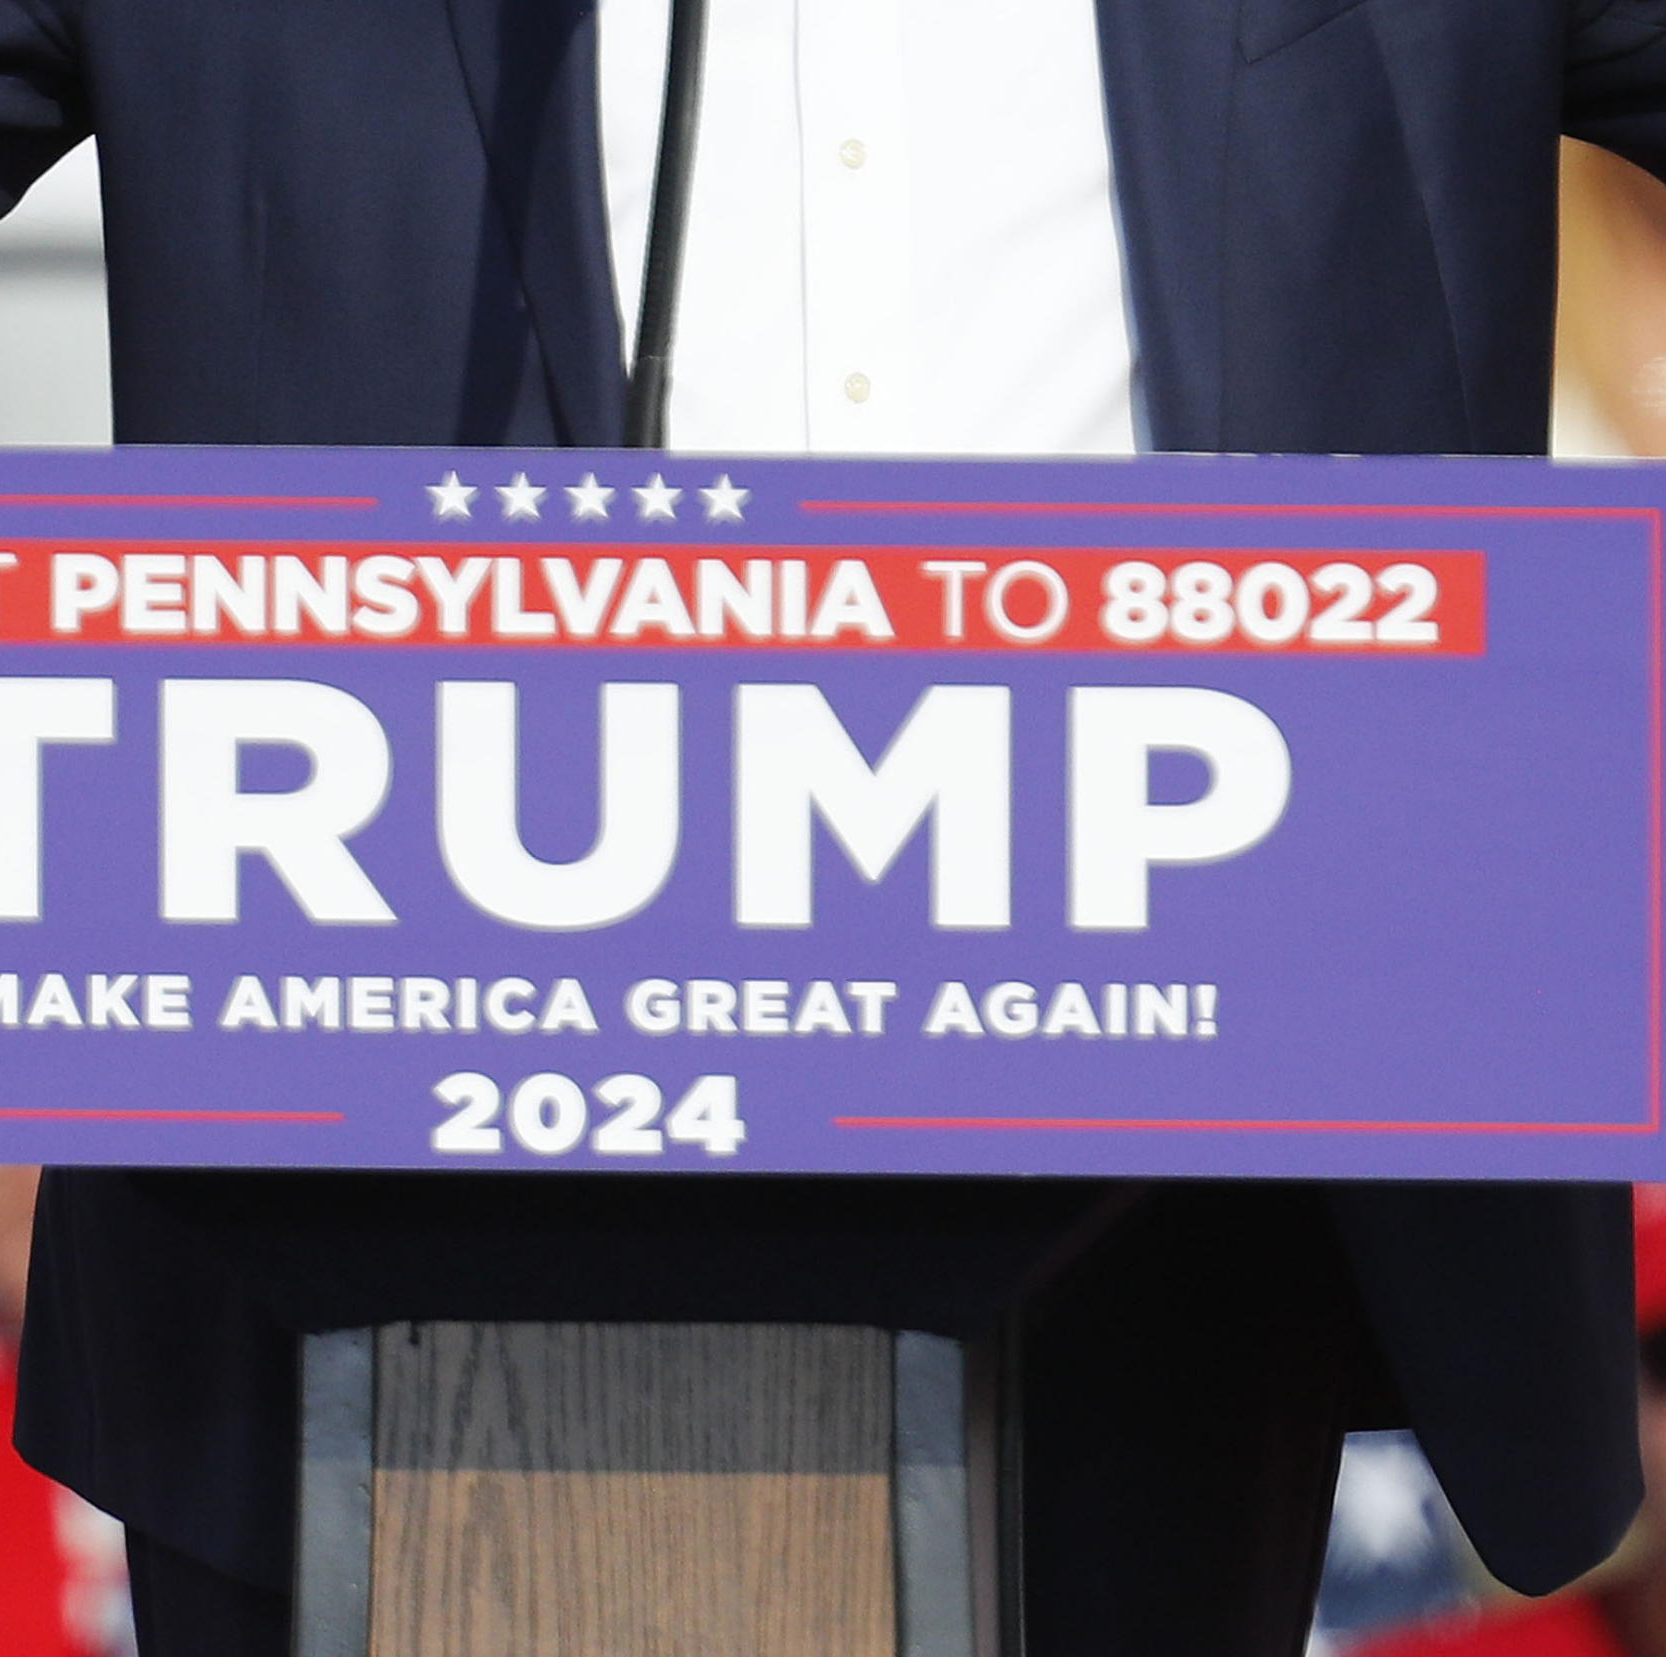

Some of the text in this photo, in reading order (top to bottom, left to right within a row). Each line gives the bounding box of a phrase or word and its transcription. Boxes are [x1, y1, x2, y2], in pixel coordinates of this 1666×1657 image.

[51, 551, 896, 641] PENNSYLVANIA
[921, 558, 1071, 643] TO
[1102, 559, 1440, 645] 88022
[219, 973, 601, 1035] AMERICA
[625, 977, 899, 1037] GREAT
[922, 980, 1220, 1039] AGAIN!
[431, 1069, 748, 1157] 2024
